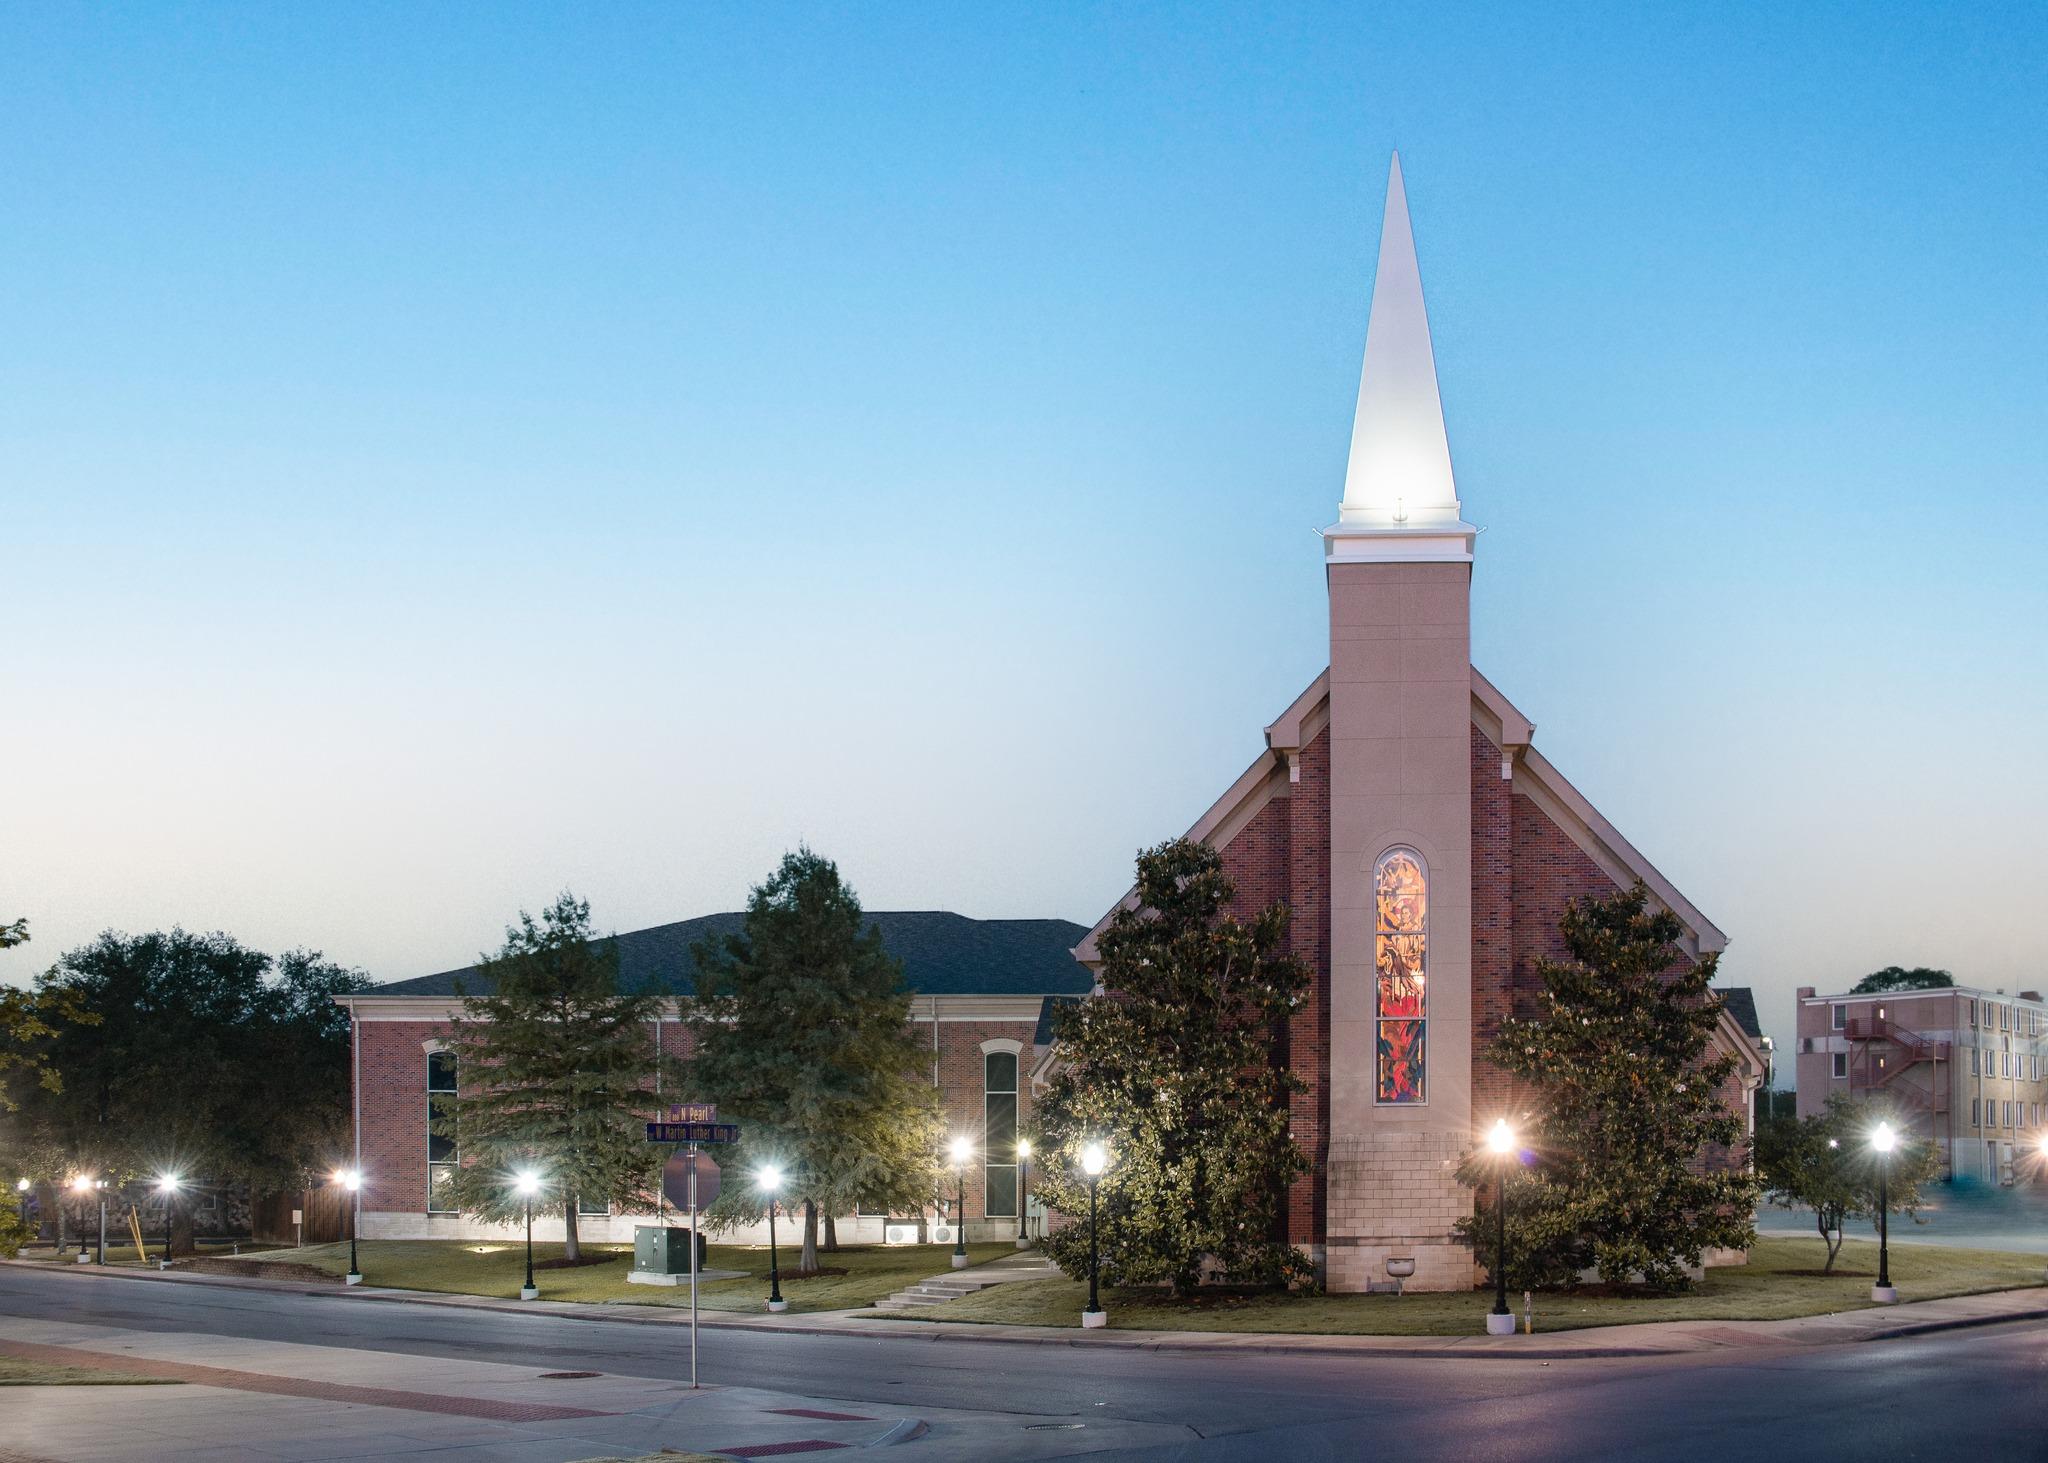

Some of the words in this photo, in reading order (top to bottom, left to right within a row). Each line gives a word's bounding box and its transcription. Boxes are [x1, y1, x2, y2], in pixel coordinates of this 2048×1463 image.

[681, 1107, 686, 1121] N
[690, 1105, 709, 1121] Pearl
[655, 1125, 662, 1140] W
[665, 1125, 687, 1140] Martin
[689, 1125, 710, 1140] Luther
[713, 1125, 728, 1142] King
